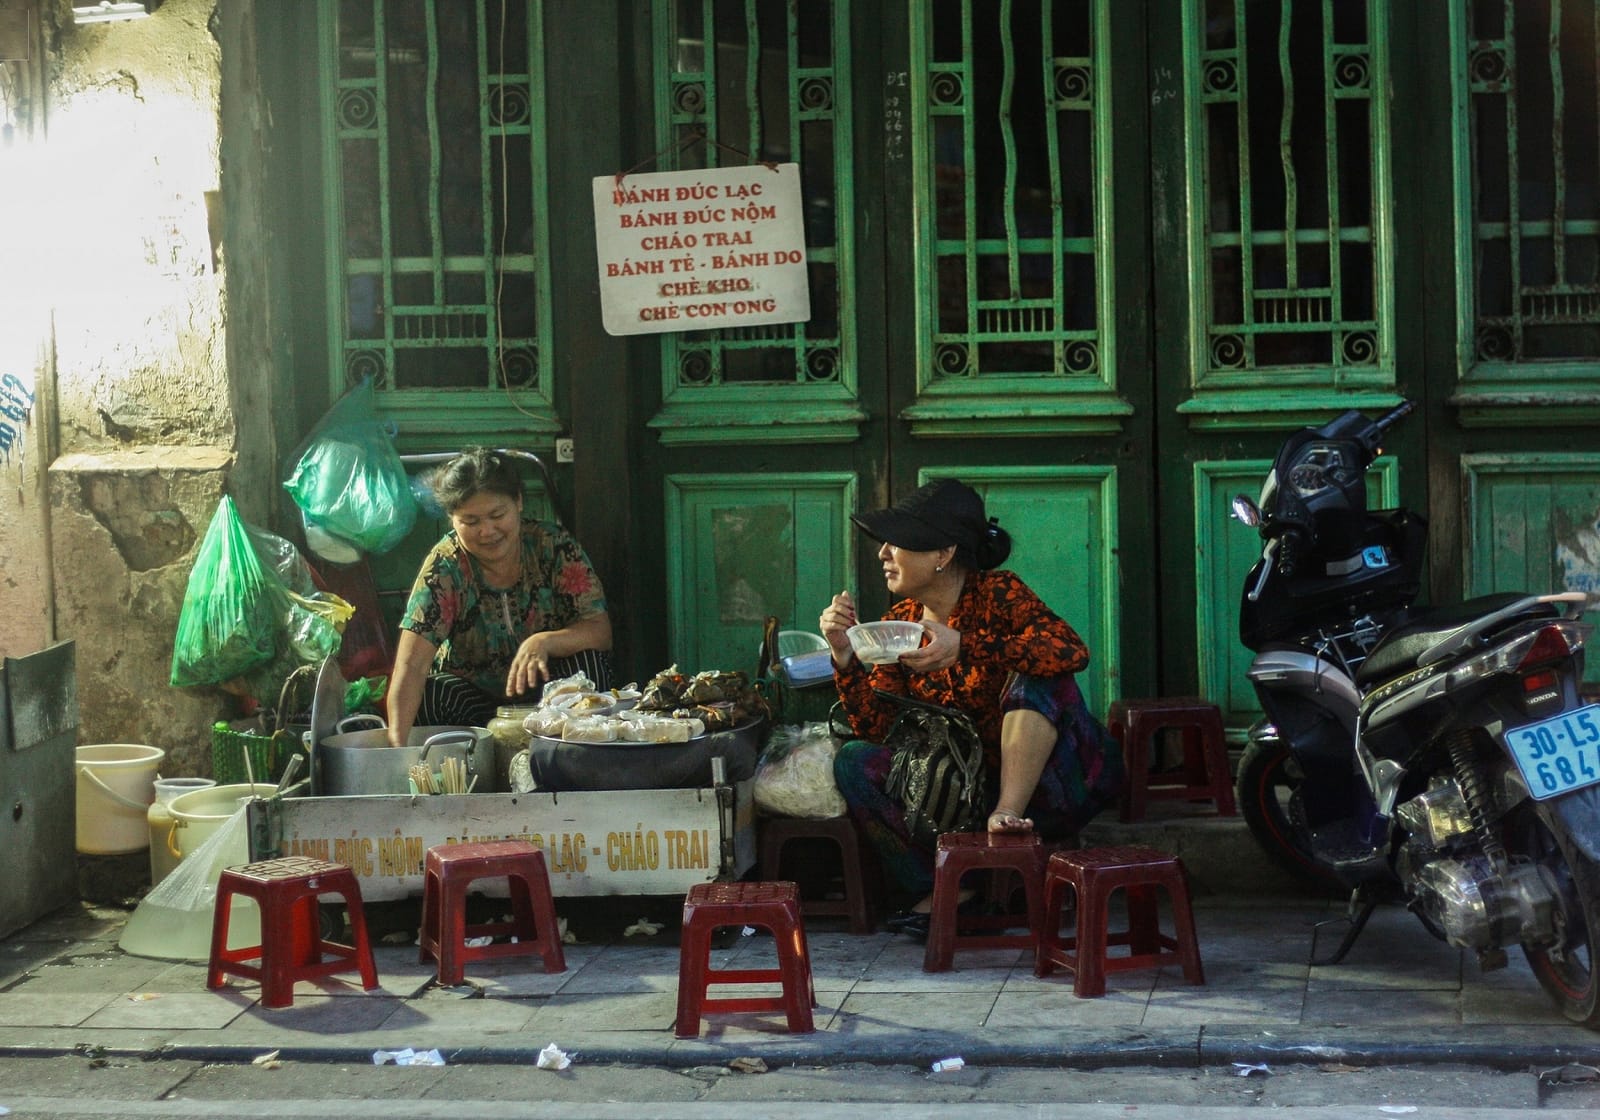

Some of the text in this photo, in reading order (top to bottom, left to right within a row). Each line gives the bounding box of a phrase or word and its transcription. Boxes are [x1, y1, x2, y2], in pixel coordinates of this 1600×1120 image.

[676, 182, 718, 201] ĐÚC
[725, 183, 762, 200] LẠC
[620, 201, 776, 228] BÁNH ĐÚC NỘM
[641, 231, 753, 251] CHÁO TRAI
[607, 258, 664, 277] BÁNH
[712, 250, 769, 270] BÁNH
[774, 250, 802, 265] DO
[661, 277, 750, 297] CHÈ KHO
[639, 299, 776, 321] CHÈ CON ONG
[1522, 712, 1599, 760] 30-L5
[1537, 745, 1600, 791] 684
[378, 827, 424, 884] NỘM
[551, 832, 587, 879] LẠC
[607, 822, 659, 873] CHÁO
[664, 829, 709, 870] TRAI
